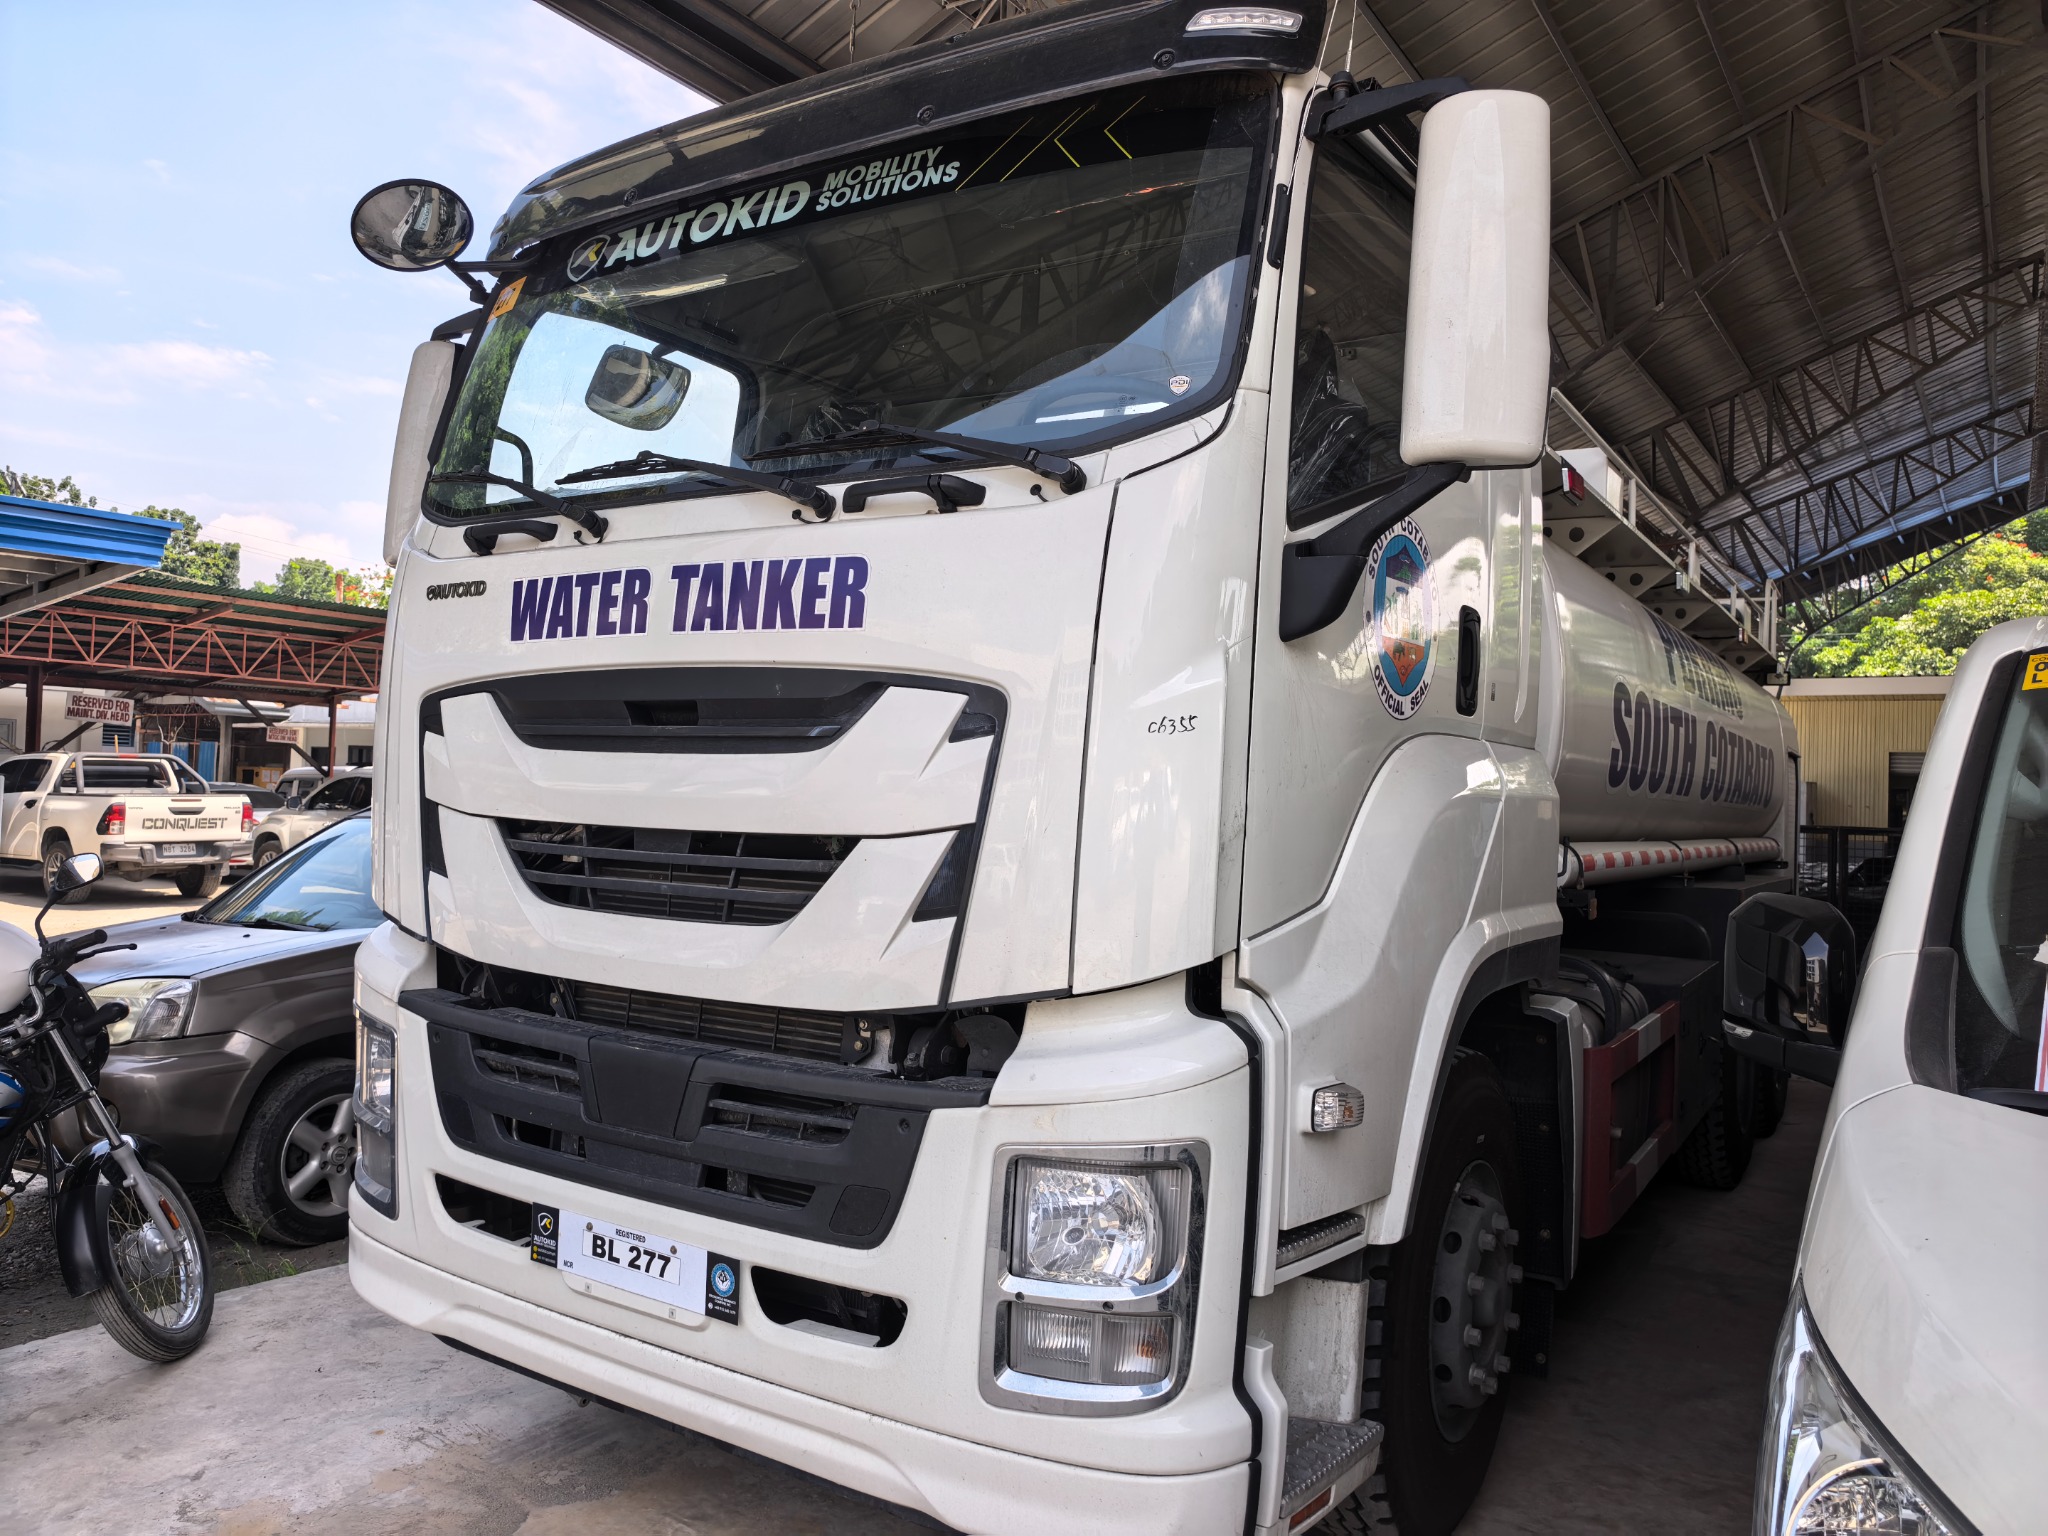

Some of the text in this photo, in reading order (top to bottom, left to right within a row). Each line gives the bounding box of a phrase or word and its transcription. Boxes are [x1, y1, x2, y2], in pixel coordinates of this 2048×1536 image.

[816, 161, 960, 212] SOLUTIONS
[823, 146, 943, 191] MOBILITY
[604, 180, 811, 268] AUTOKID
[434, 580, 487, 600] AUTOKID
[510, 556, 869, 642] WATER TANKER
[71, 695, 130, 712] RESERVED FOR
[1373, 664, 1429, 716] OFFICIAL SEAL
[110, 711, 130, 722] HEAD
[1608, 681, 1775, 809] SOUTH COTABATO
[142, 817, 228, 831] CONQUEST
[592, 1233, 671, 1278] BL 277
[615, 1228, 646, 1243] REGISTERED
